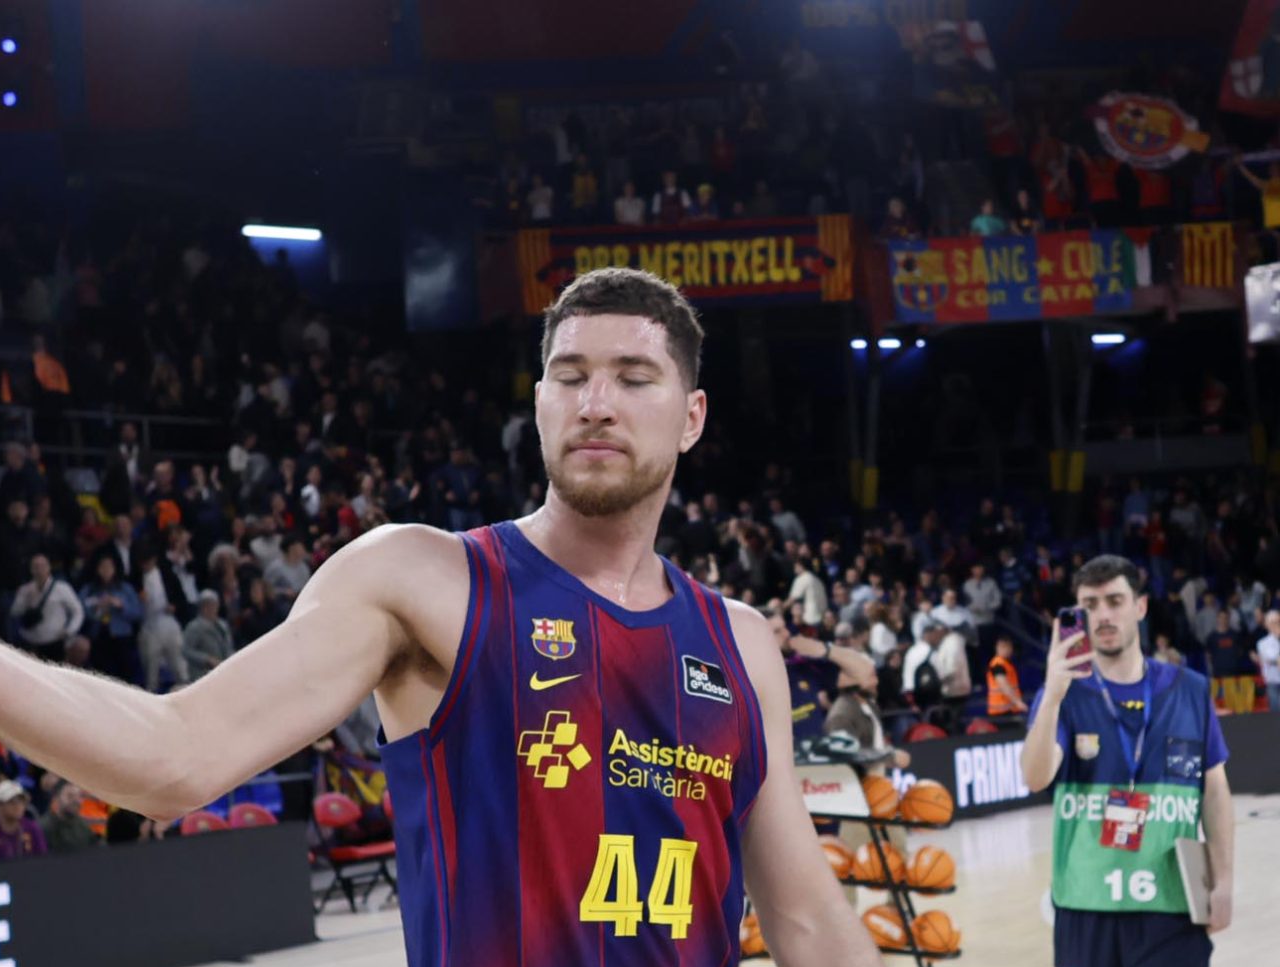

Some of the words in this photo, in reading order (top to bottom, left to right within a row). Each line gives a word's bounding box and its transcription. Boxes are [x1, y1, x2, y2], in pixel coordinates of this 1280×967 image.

[639, 236, 802, 287] MERITXELL
[951, 244, 1029, 286] SANG
[689, 666, 709, 682] liga
[690, 680, 730, 698] endesa
[1060, 793, 1200, 825] OPECIONS
[580, 833, 698, 939] 44
[1104, 868, 1158, 903] 16
